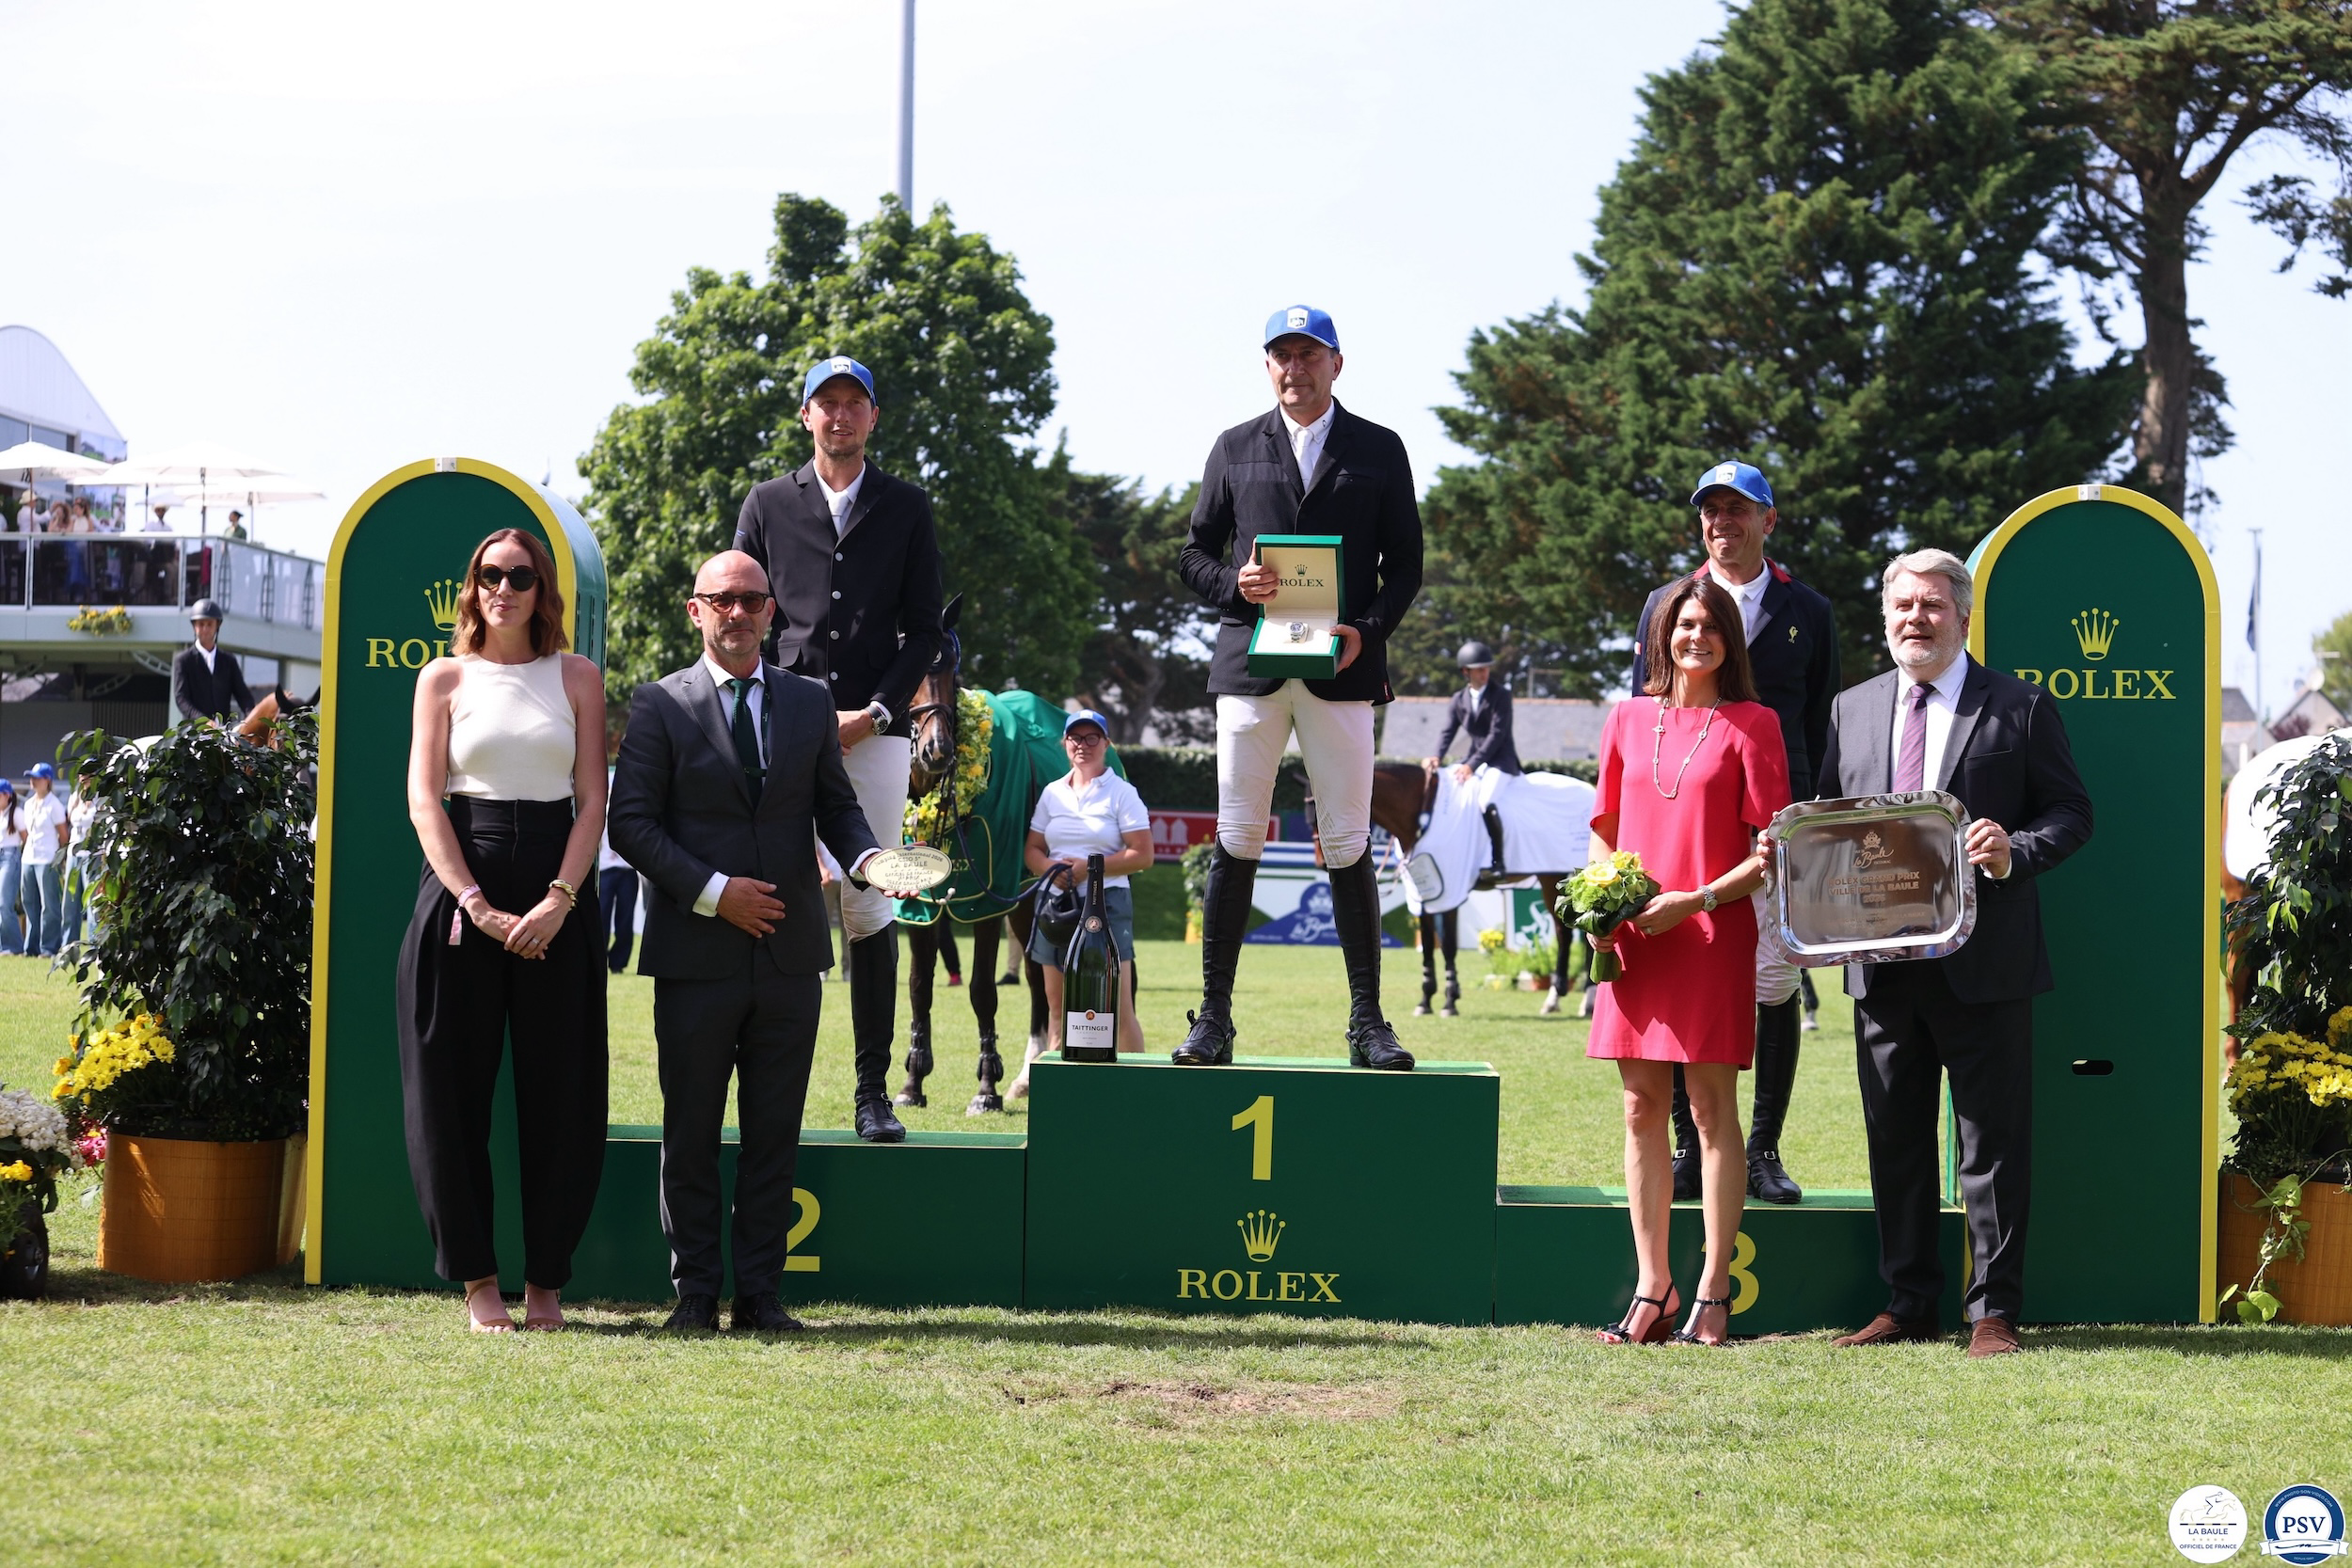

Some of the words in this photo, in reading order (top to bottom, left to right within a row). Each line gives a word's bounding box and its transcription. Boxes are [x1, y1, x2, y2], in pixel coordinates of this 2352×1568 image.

[1279, 578, 1325, 587] ROLEX
[1829, 887, 1855, 895] VILLE
[1872, 883, 1885, 892] LA
[1887, 881, 1919, 892] BAULE
[1862, 874, 1895, 883] GRAND
[1897, 871, 1920, 880] PRIX
[1232, 1095, 1274, 1180] 1
[783, 1187, 820, 1272] 2
[1177, 1269, 1342, 1303] ROLEX
